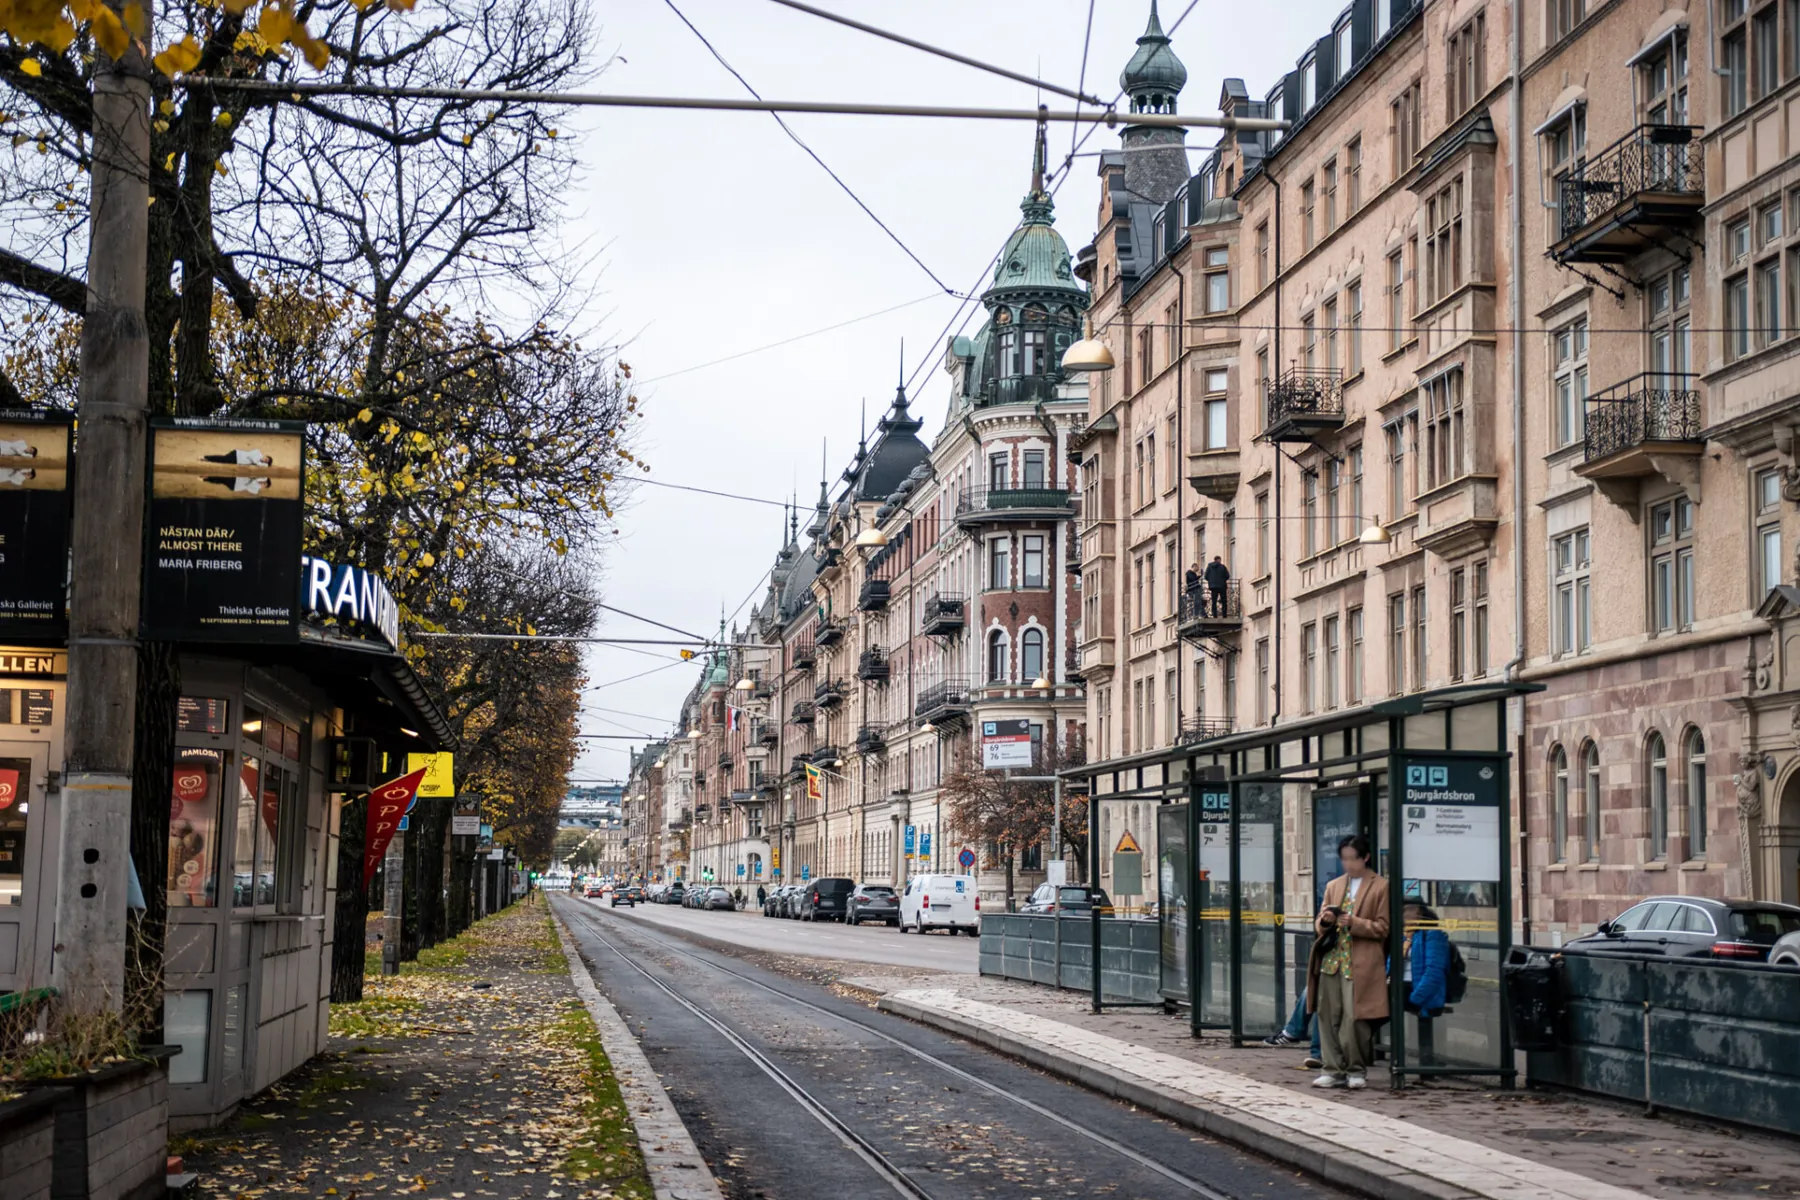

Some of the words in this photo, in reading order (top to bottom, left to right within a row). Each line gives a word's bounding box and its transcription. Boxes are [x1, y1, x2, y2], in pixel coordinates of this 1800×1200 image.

[160, 526, 203, 537] NÄSTAN
[206, 527, 235, 538] DÄR/
[160, 540, 204, 550] ALMOST
[207, 541, 243, 551] THERE
[159, 559, 193, 568] MARIA
[196, 560, 243, 570] FRIBERG
[0, 600, 15, 609] ska
[17, 600, 54, 610] Galleriet
[219, 606, 253, 615] Thielska
[255, 607, 290, 616] Galleriet
[989, 744, 999, 752] 69
[1407, 789, 1475, 802] Djurgårdsbron
[1413, 808, 1420, 817] 7
[368, 786, 410, 867] ÖPPET
[906, 826, 913, 834] P
[923, 835, 929, 843] P
